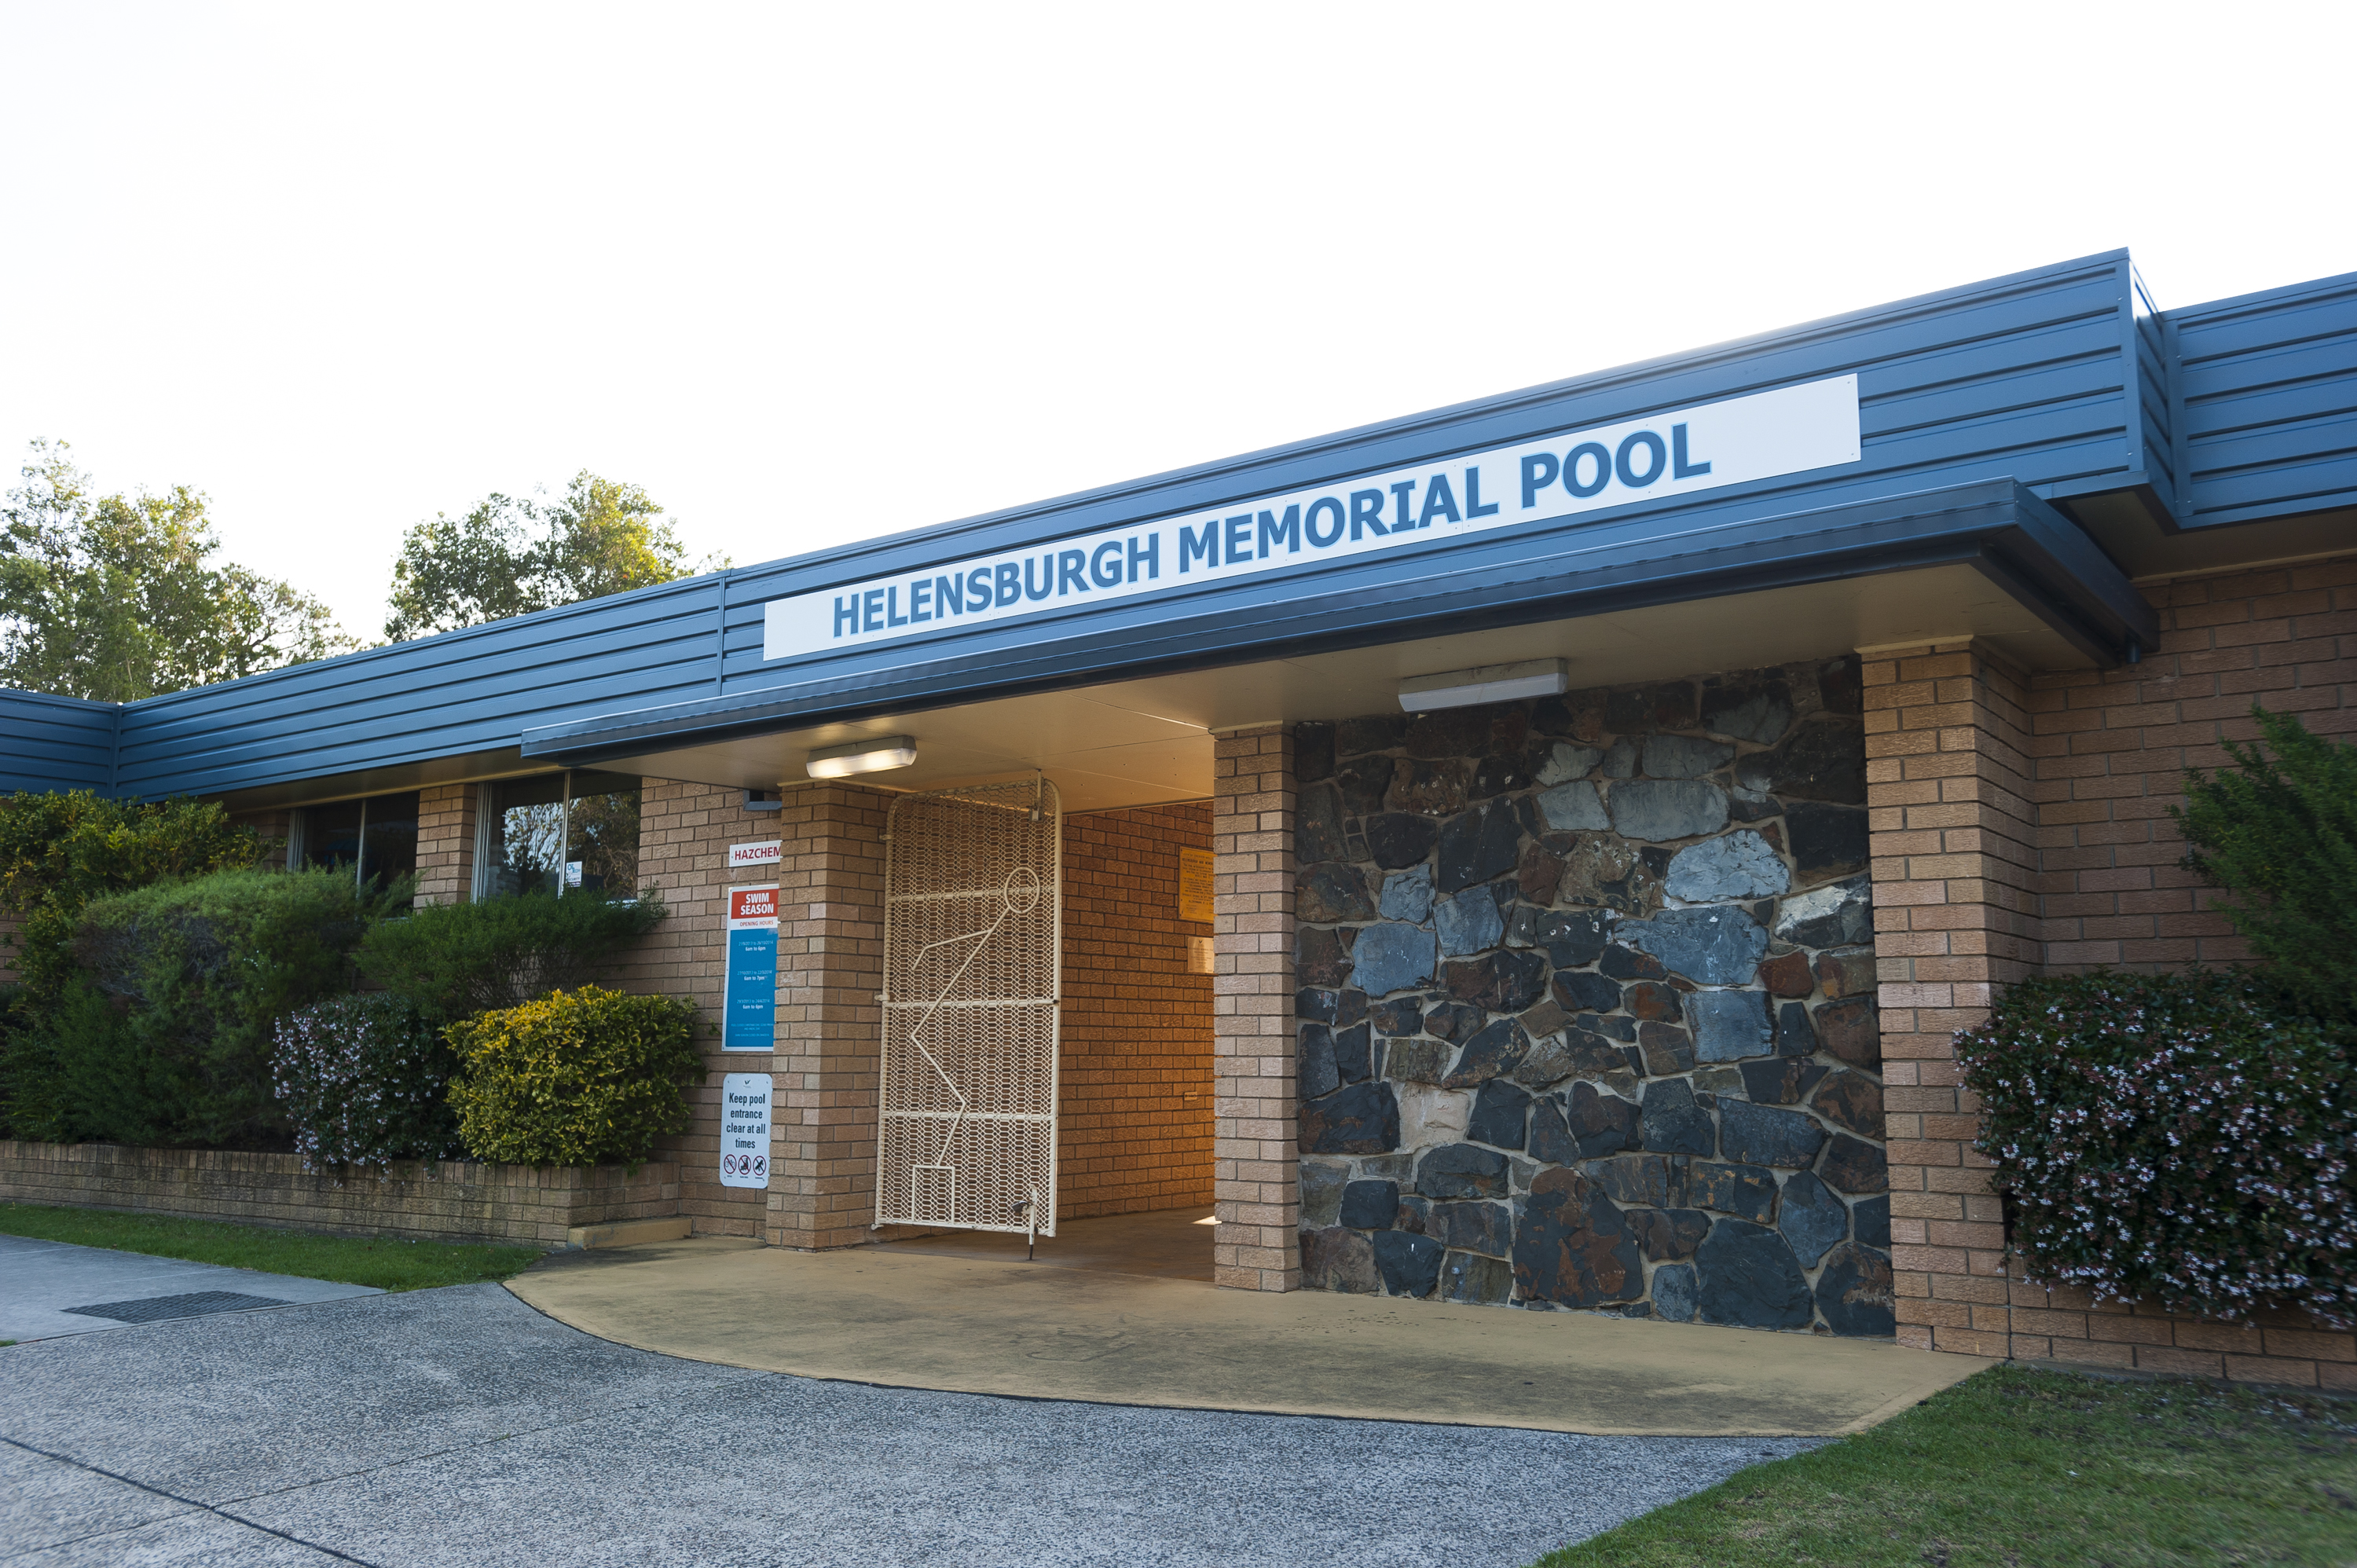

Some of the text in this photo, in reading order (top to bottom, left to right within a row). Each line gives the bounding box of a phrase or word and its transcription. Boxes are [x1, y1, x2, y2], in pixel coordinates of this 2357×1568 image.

[833, 421, 1713, 639] HELENSBURGH MEMORIAL POOL
[735, 846, 781, 861] HAZCHEM
[746, 892, 769, 904] SWIM
[740, 903, 774, 915] SEASON
[729, 1093, 765, 1106] Keep pool
[731, 1108, 763, 1119] entrance
[726, 1122, 766, 1134] clear at all
[735, 1138, 756, 1149] times
